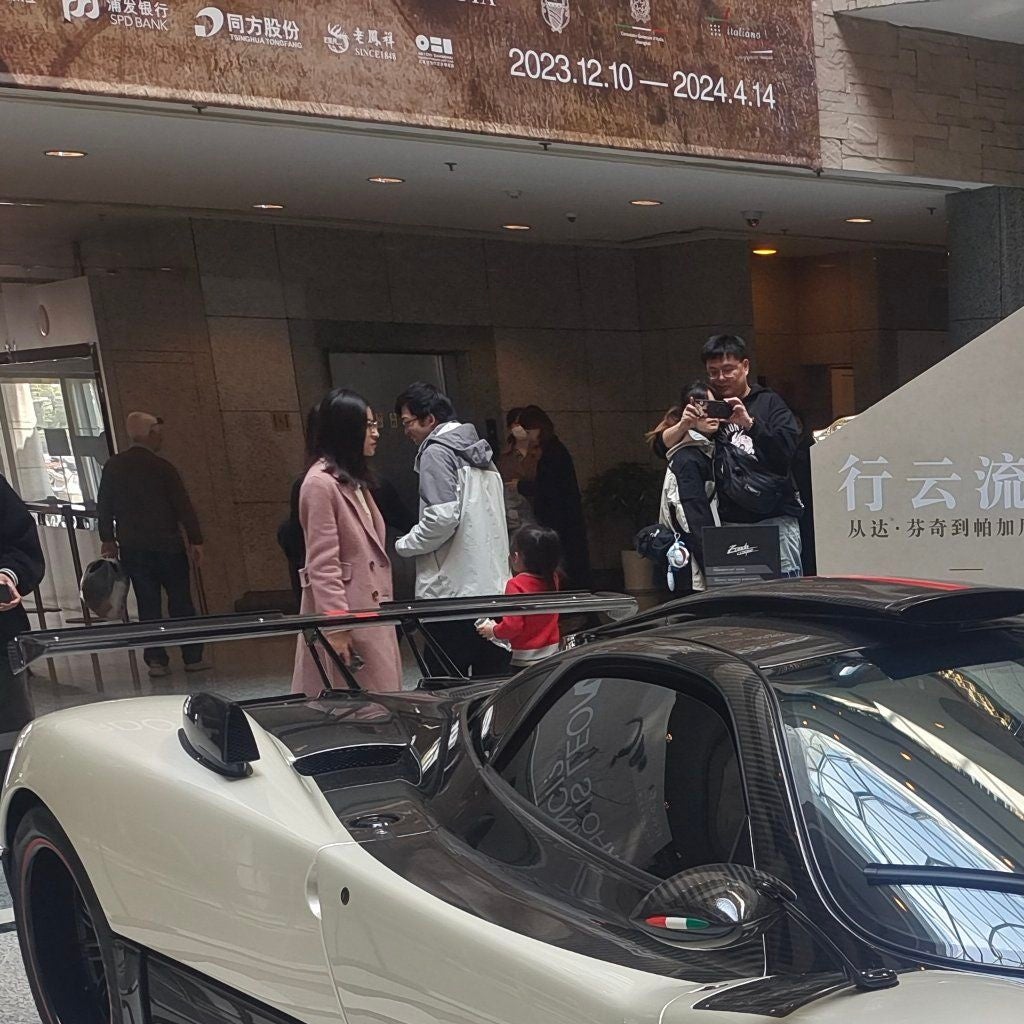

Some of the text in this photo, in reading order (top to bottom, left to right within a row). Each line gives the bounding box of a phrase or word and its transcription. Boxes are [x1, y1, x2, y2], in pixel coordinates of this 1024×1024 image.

[107, 0, 169, 18] 浦发银行
[110, 14, 169, 31] SPD BANK
[226, 13, 300, 41] 同方股份
[509, 47, 633, 92] 2023.12.10
[672, 70, 776, 109] 2024.4.14
